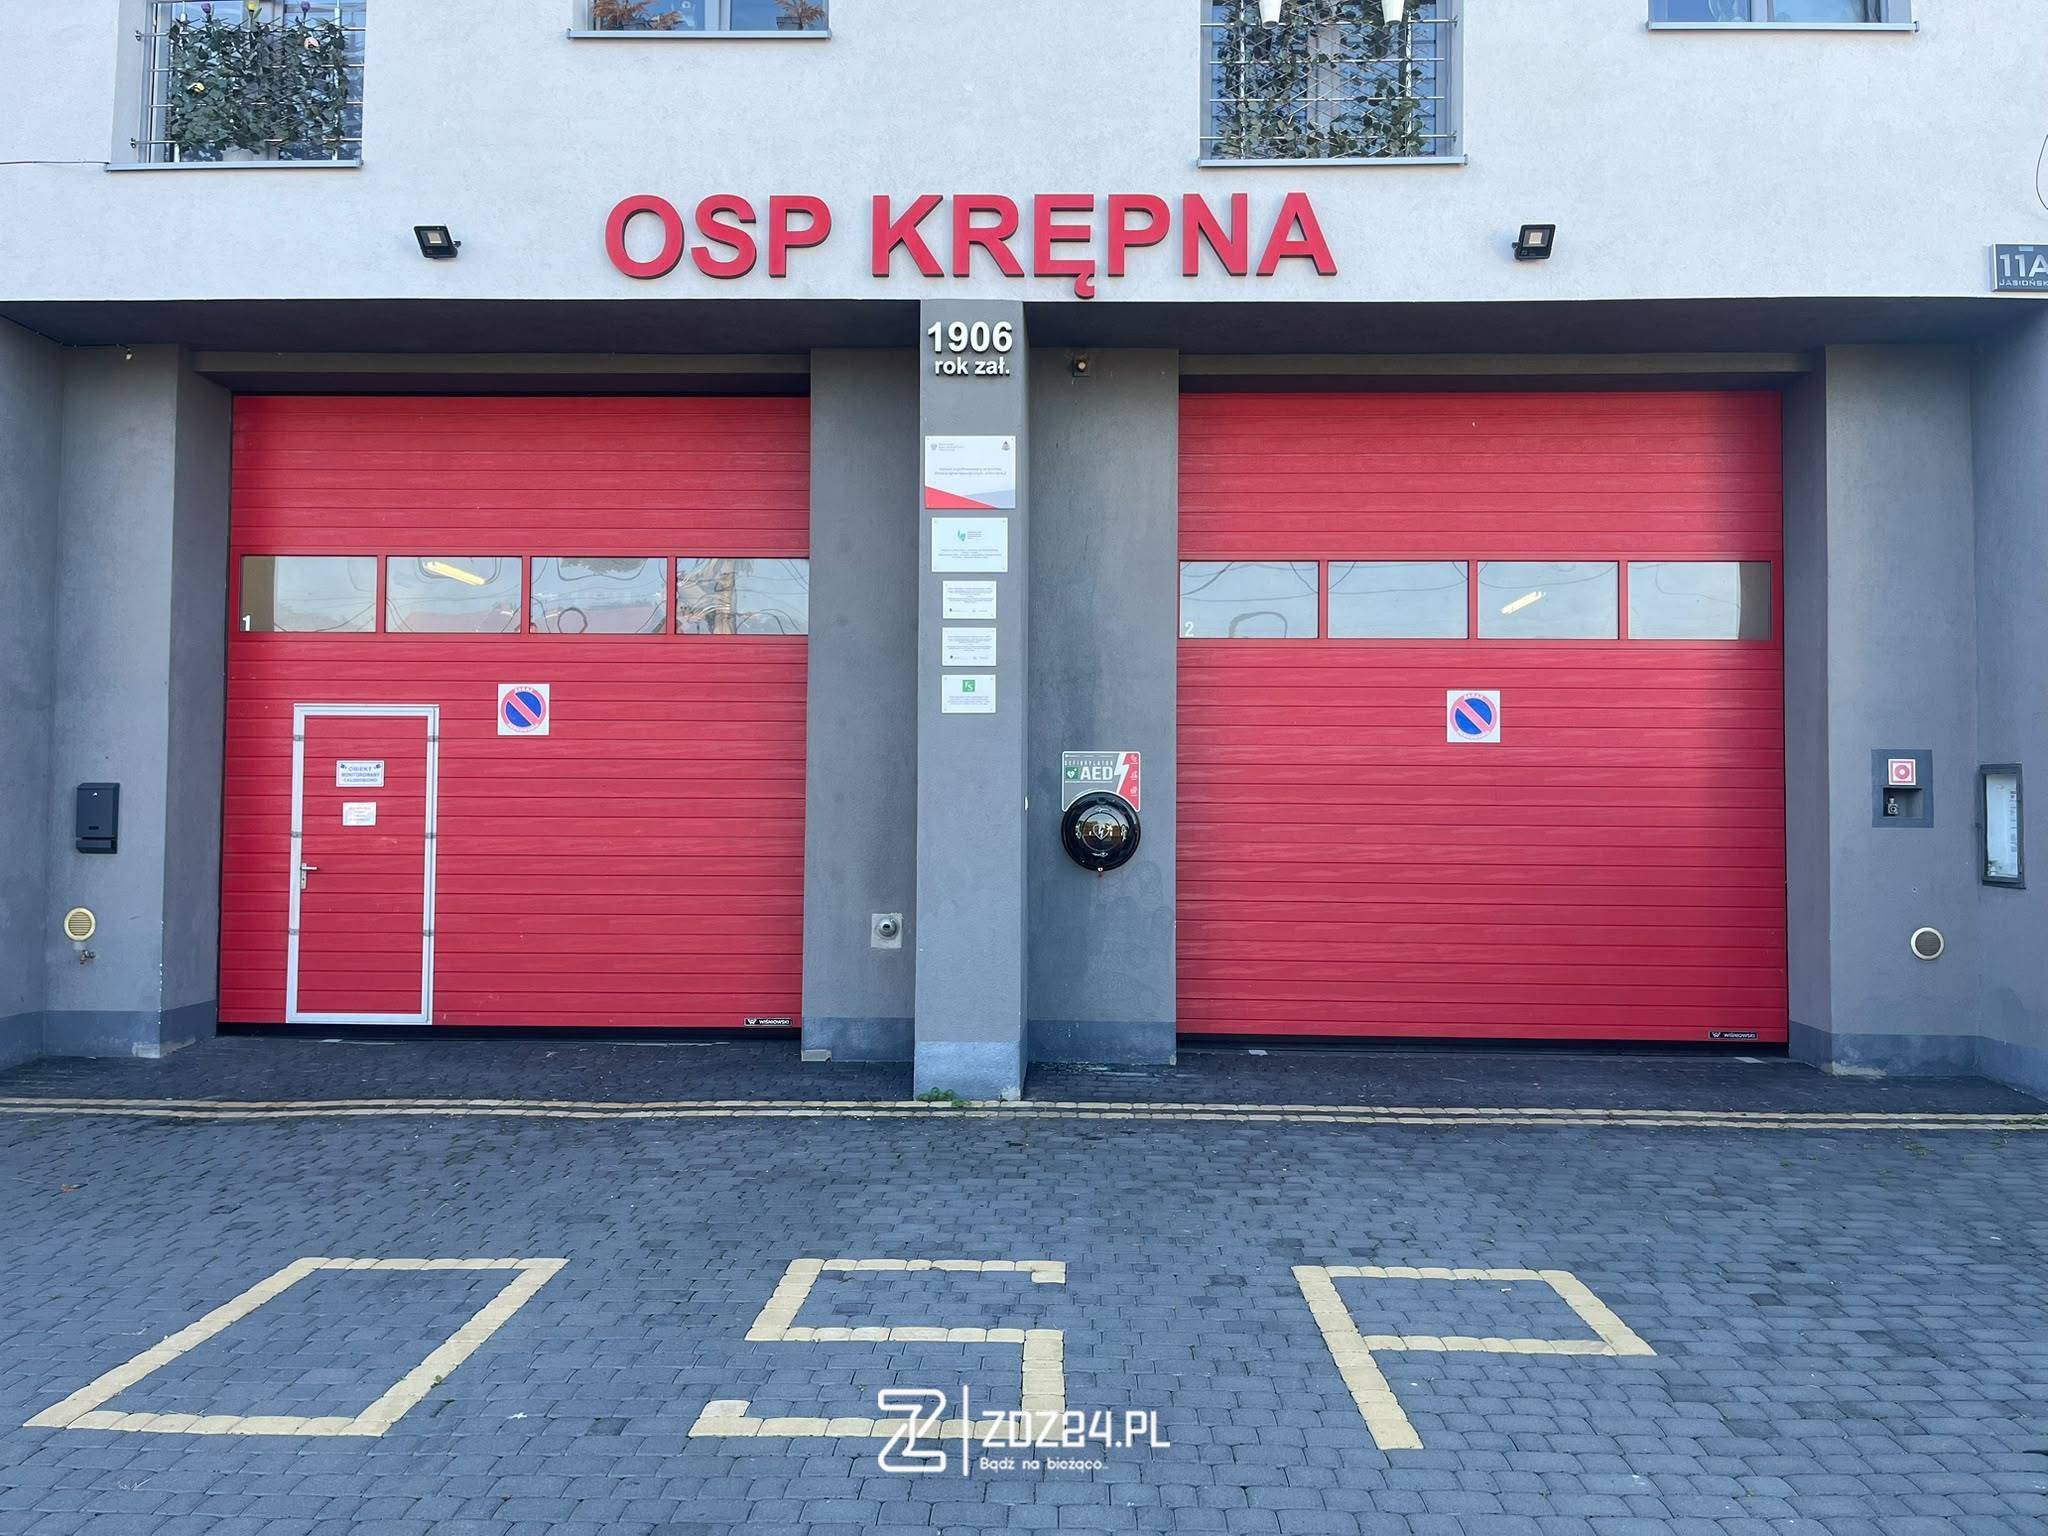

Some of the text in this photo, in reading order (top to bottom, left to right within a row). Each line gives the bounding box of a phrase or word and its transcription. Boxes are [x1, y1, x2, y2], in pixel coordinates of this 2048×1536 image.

[604, 192, 1338, 299] OSP KRĘPNA
[1999, 254, 2048, 277] 11A
[927, 321, 1013, 353] 1906
[934, 356, 1010, 376] rok zał.
[242, 615, 251, 632] 1
[1184, 621, 1194, 637] 2
[1080, 766, 1113, 780] AED
